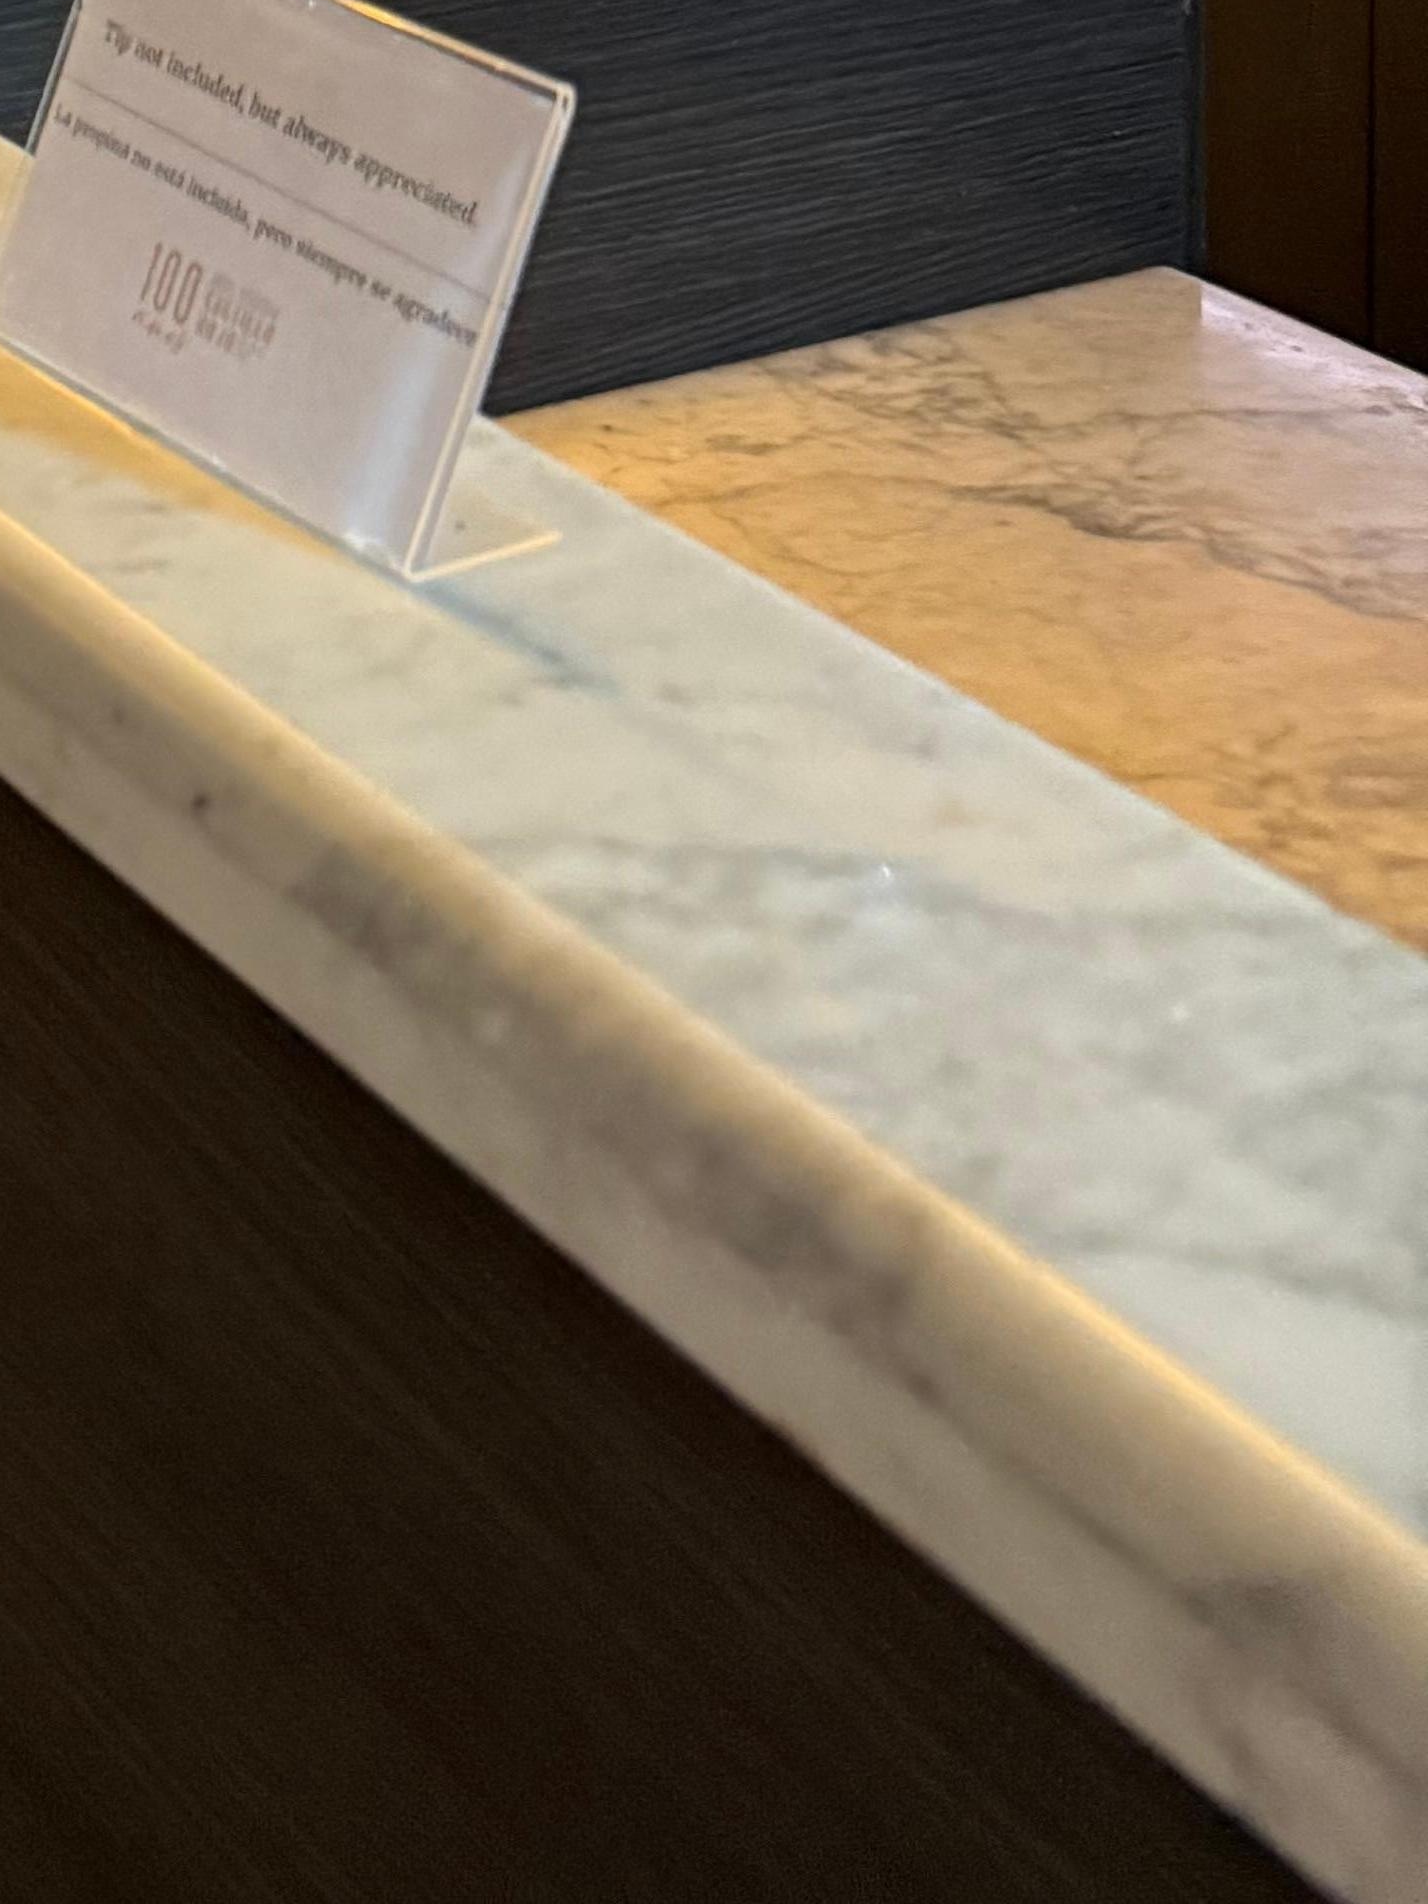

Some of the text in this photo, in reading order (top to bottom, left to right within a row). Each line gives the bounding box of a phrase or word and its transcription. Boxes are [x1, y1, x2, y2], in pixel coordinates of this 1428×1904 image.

[105, 18, 132, 56] Tip
[133, 39, 164, 68] not
[166, 51, 245, 115] included,
[248, 90, 282, 129] but
[282, 113, 352, 166] always
[140, 242, 204, 325] 100
